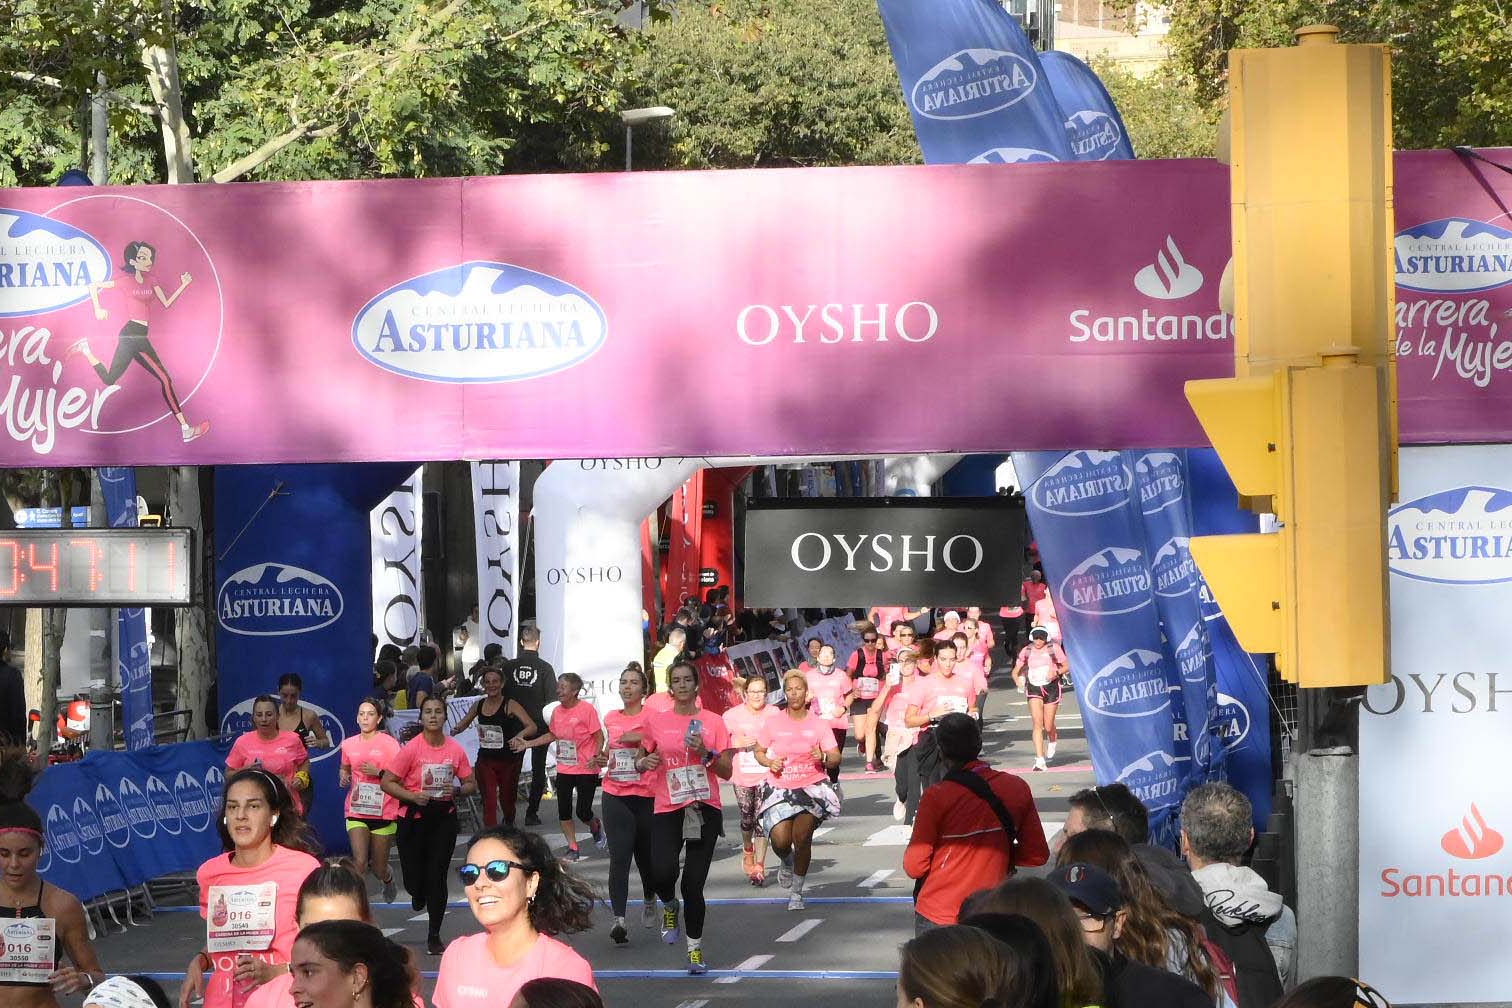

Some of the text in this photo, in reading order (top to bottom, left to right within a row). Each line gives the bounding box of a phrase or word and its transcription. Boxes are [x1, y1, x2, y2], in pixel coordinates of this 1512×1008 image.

[371, 308, 587, 353] ASTURIANA
[735, 299, 940, 347] OYSHO
[1418, 329, 1436, 357] la
[1415, 520, 1481, 531] CENTRAL
[791, 531, 984, 574] OYSHO
[547, 565, 623, 586] OYSHO
[221, 592, 335, 620] ASTURIANA
[519, 670, 532, 680] BP
[229, 911, 252, 921] 016
[7, 943, 32, 953] 016
